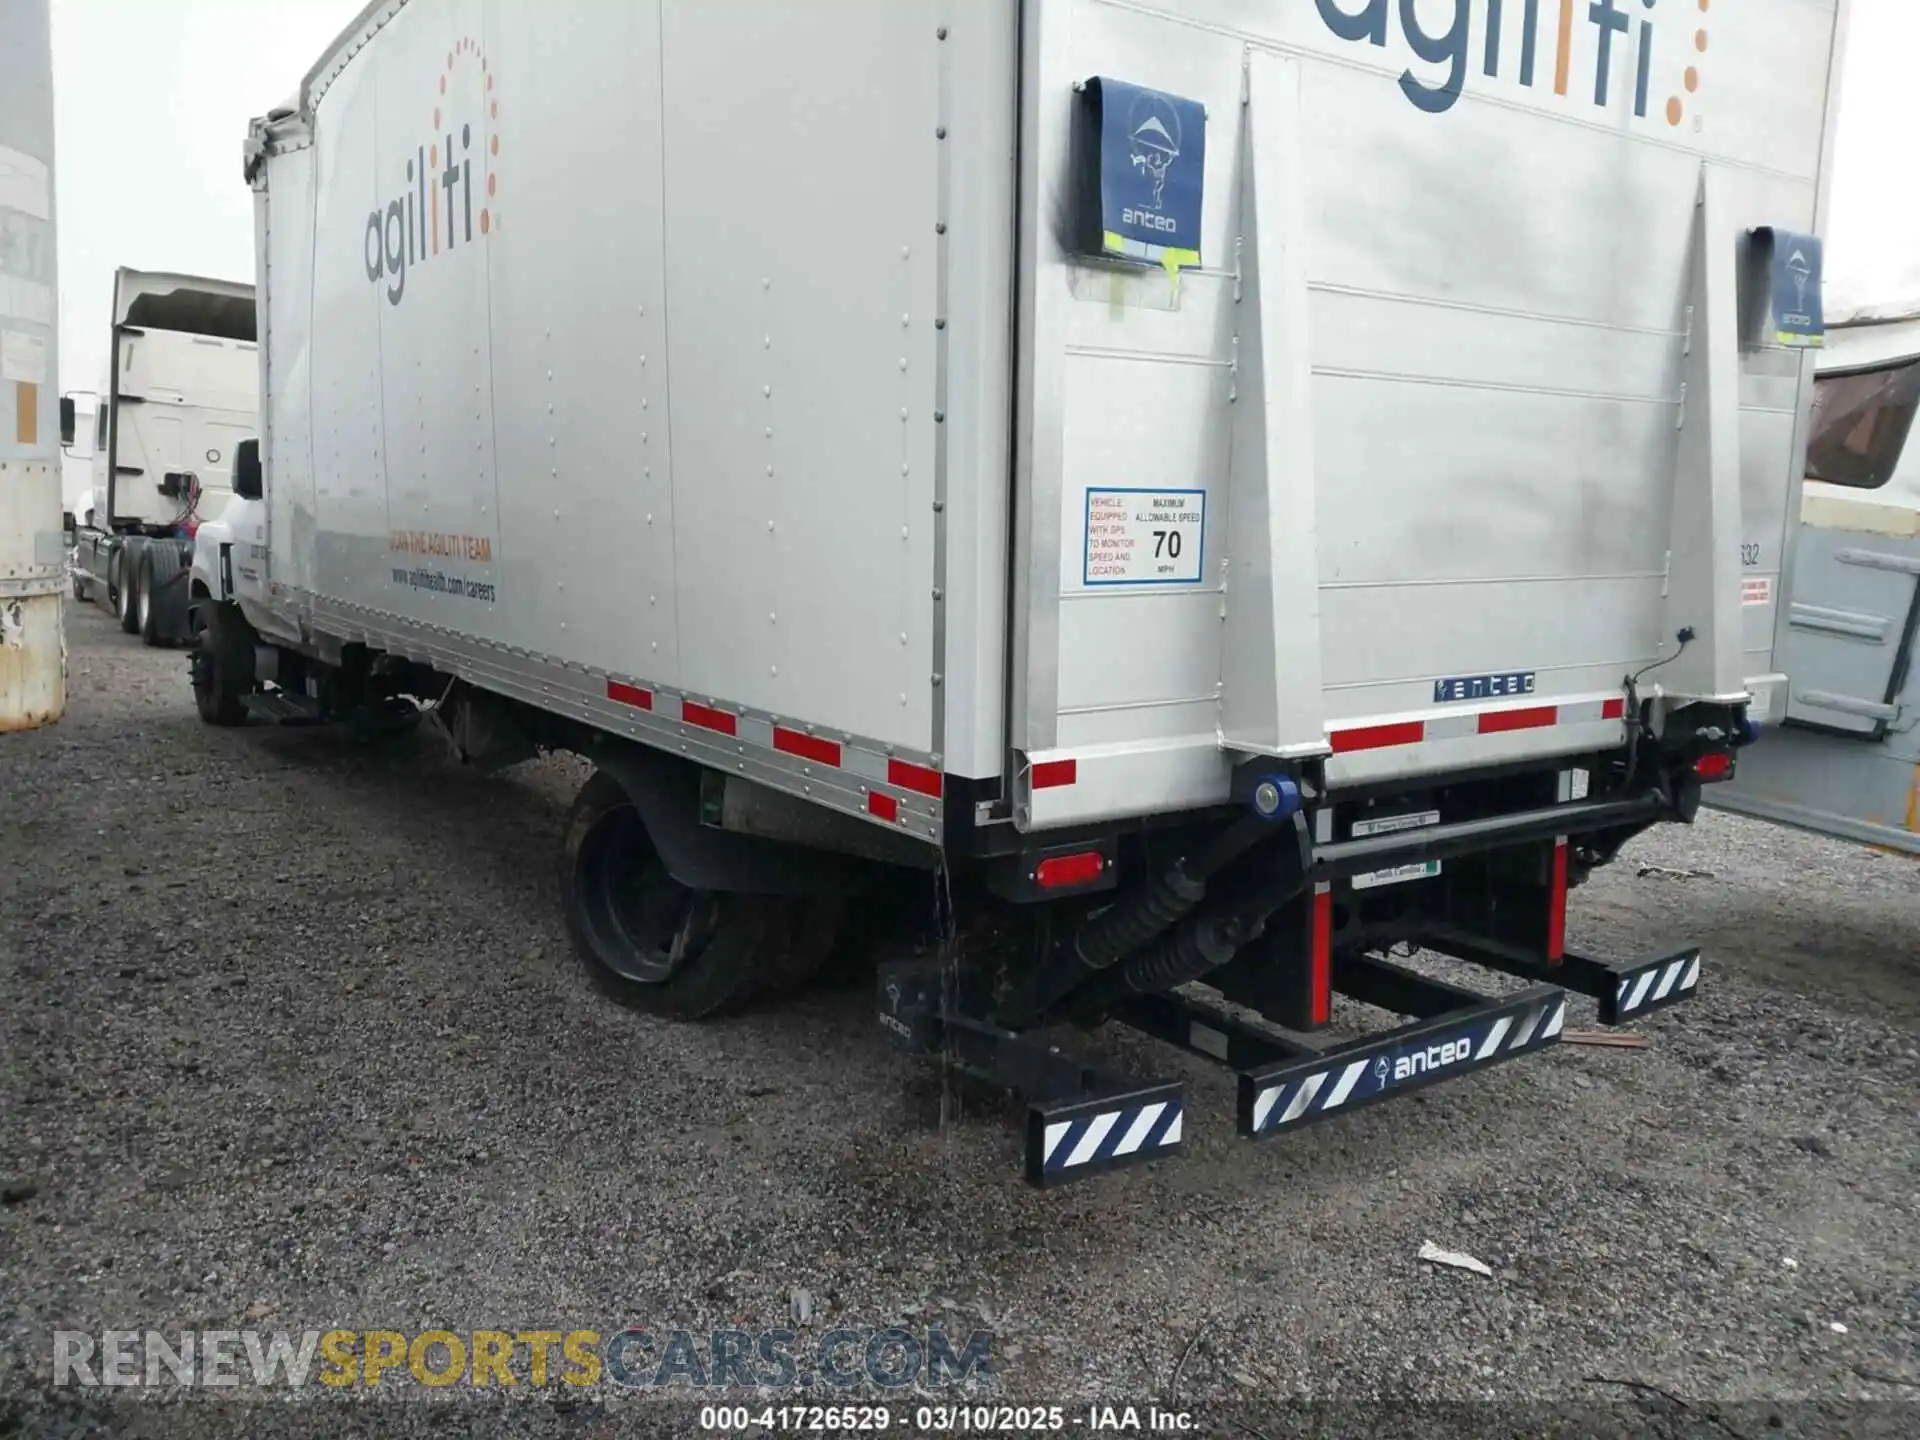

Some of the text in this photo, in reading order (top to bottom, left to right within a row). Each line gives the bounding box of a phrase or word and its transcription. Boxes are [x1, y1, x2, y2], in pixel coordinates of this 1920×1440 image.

[365, 123, 471, 306] agiliti
[1122, 207, 1177, 233] anteo
[1091, 498, 1124, 507] VEHICLE
[1153, 498, 1185, 508] MAXIMUM
[1090, 511, 1128, 521] EQUIPPED
[1135, 512, 1201, 522] ALLOWABLE SPEED
[1089, 525, 1125, 535] WITH GPS
[462, 535, 492, 562] TEAM
[1089, 539, 1135, 548] TO MONITOR
[1152, 530, 1181, 558] 70
[1088, 552, 1131, 561] SPEED AND
[1088, 566, 1125, 576] LOCATION
[1157, 565, 1175, 573] MPH
[1394, 1038, 1471, 1080] anteo
